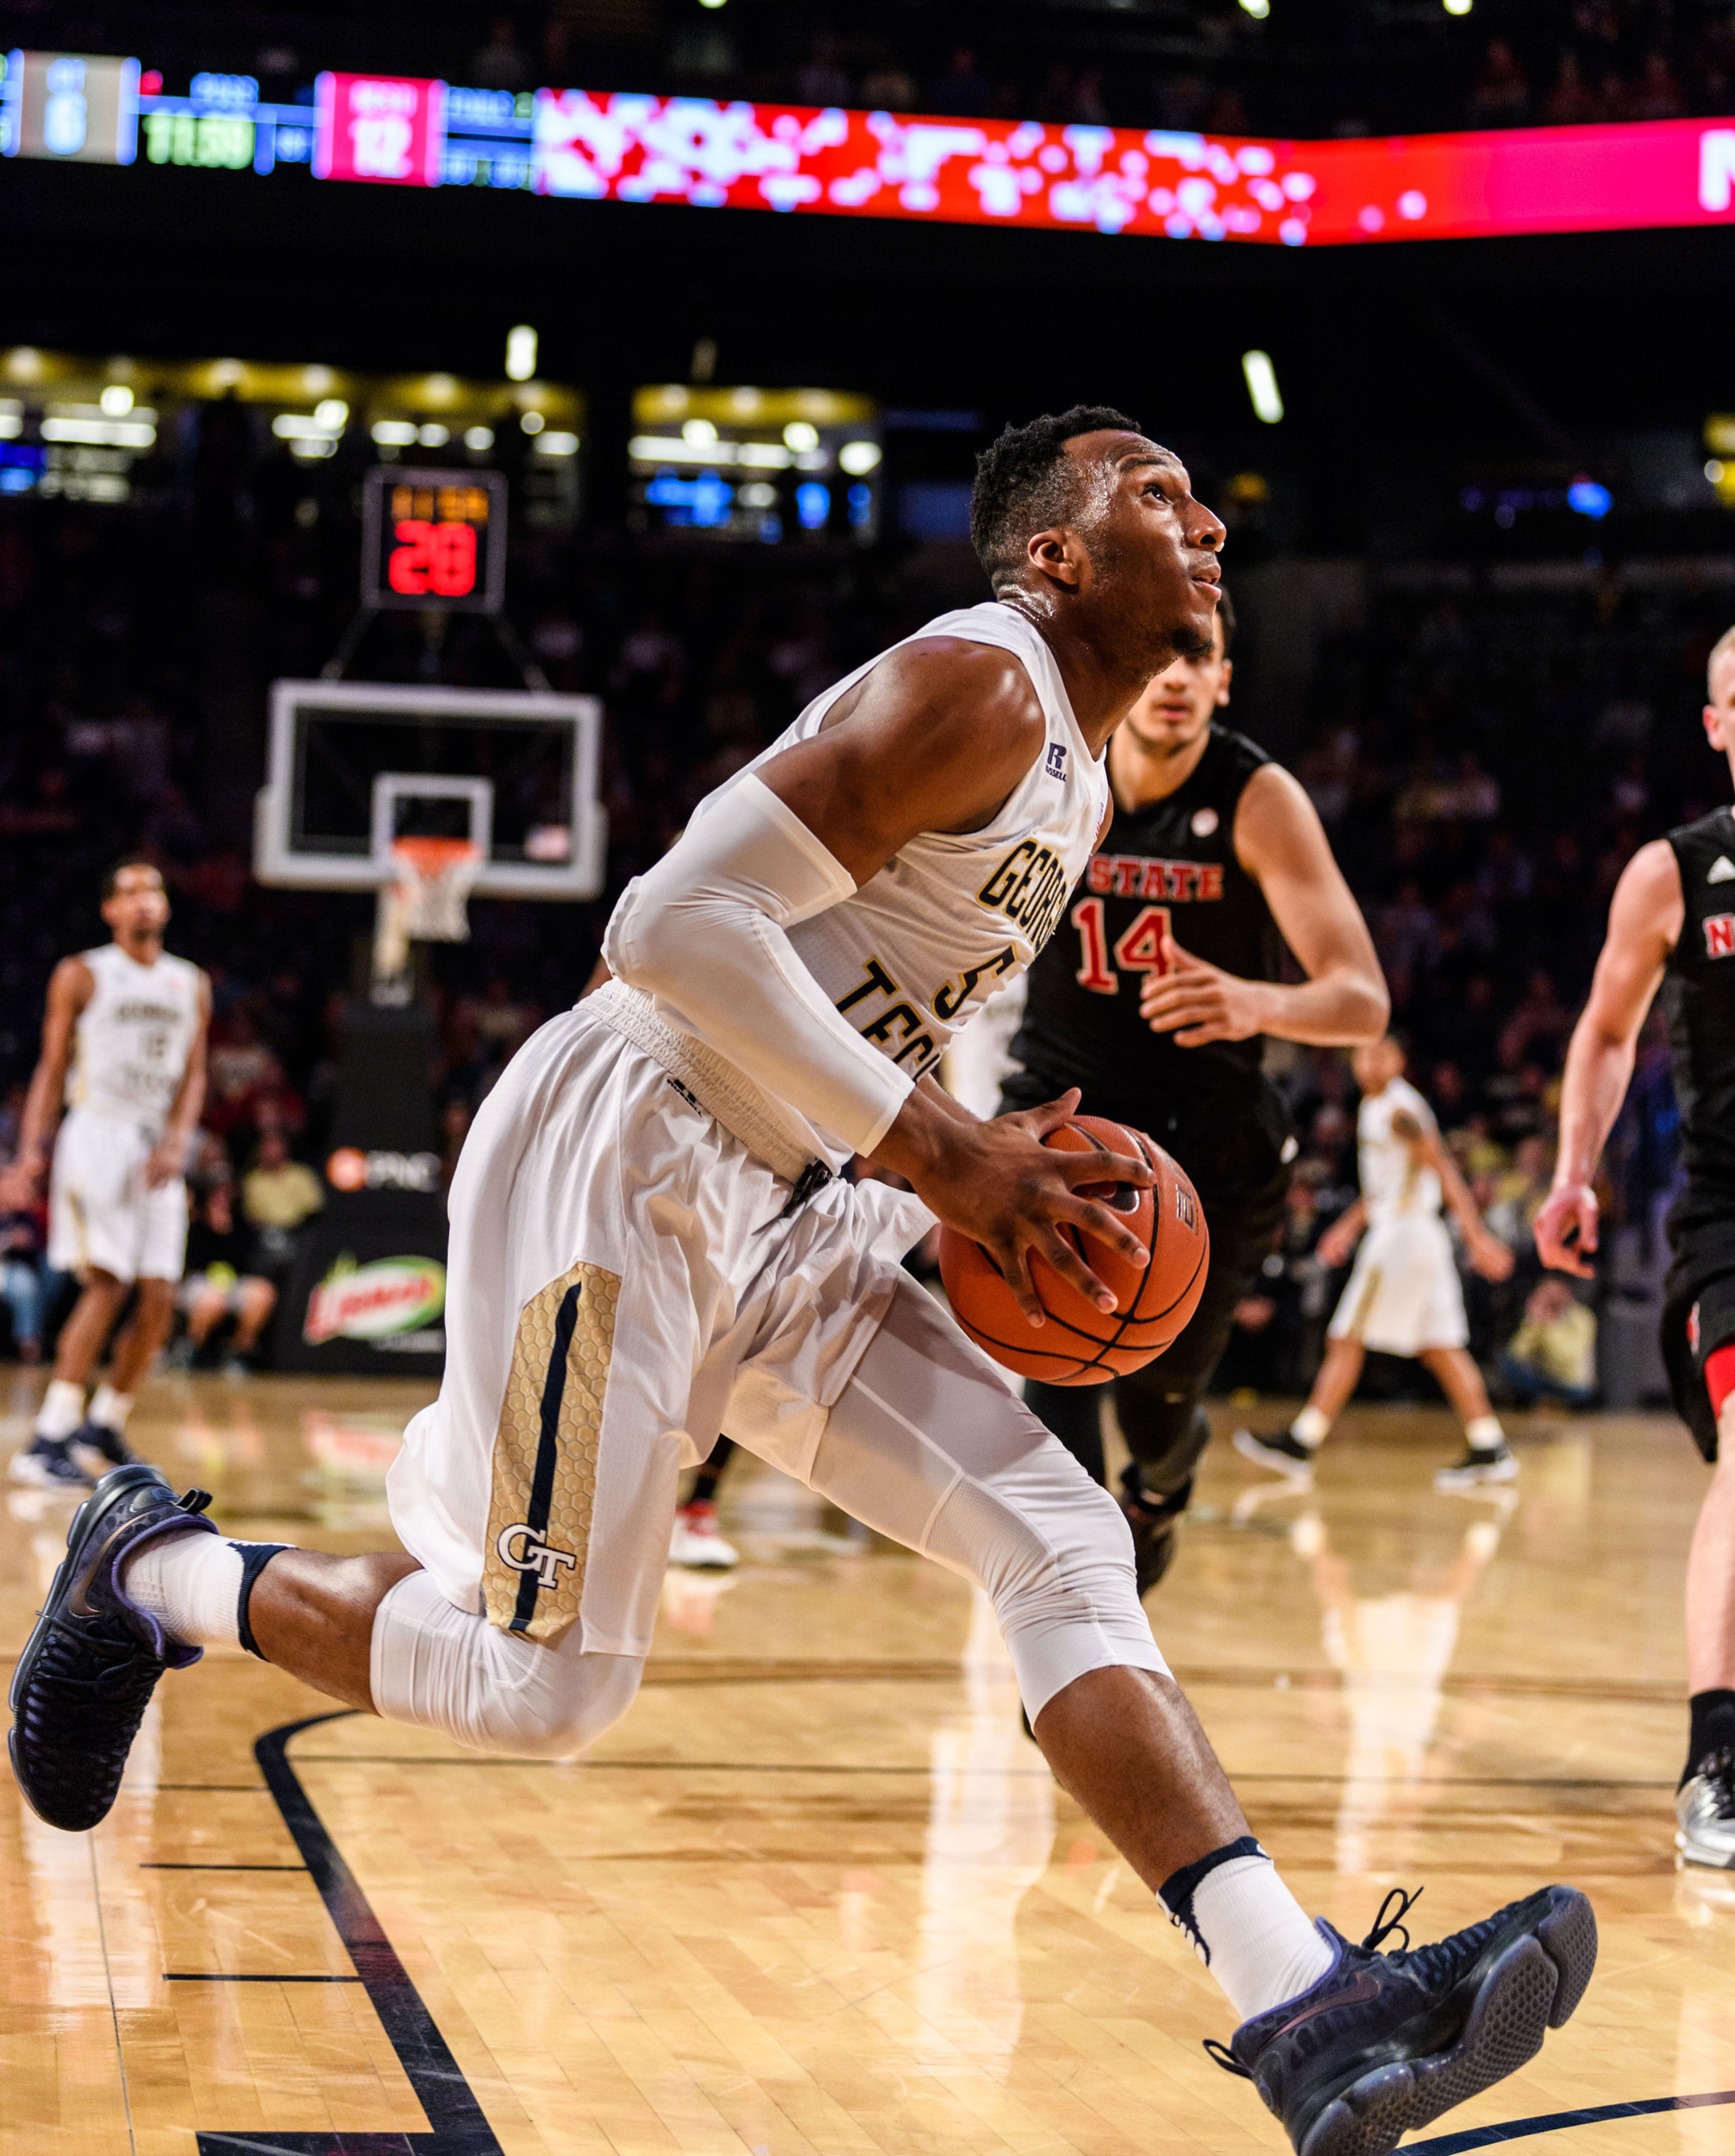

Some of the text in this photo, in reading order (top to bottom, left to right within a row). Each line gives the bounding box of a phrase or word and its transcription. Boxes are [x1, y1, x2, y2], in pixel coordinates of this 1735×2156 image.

[975, 837, 1068, 958] GEORG
[1087, 852, 1225, 903] STATE
[930, 940, 1019, 1023] 5
[1071, 896, 1172, 995] 14
[498, 1522, 577, 1589] GT
